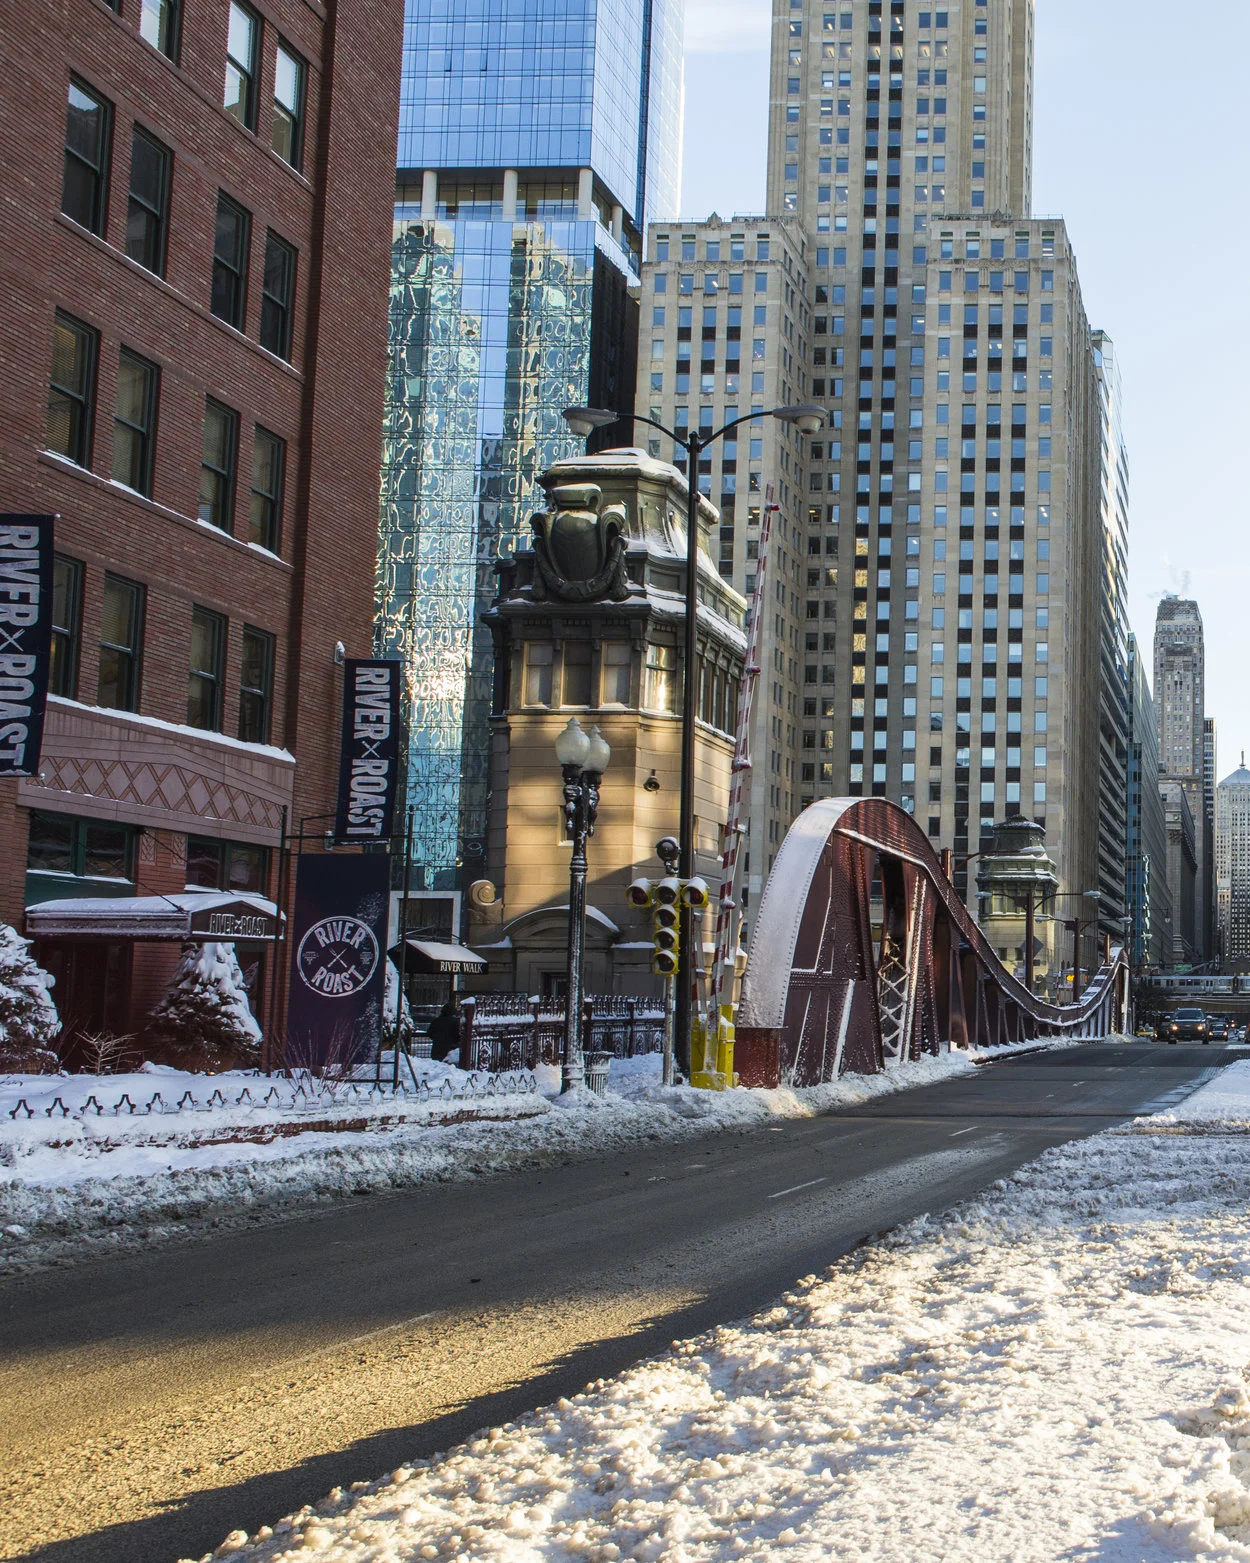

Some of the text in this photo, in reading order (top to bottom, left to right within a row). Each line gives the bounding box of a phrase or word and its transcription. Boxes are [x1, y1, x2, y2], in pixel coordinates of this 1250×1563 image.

[0, 525, 40, 627] RIVER
[346, 667, 391, 836] RIVER ROAST
[209, 913, 268, 937] RIVER ROAST
[314, 920, 366, 949] RIVER
[311, 965, 364, 993] ROAST
[440, 960, 483, 974] RIVER WALK
